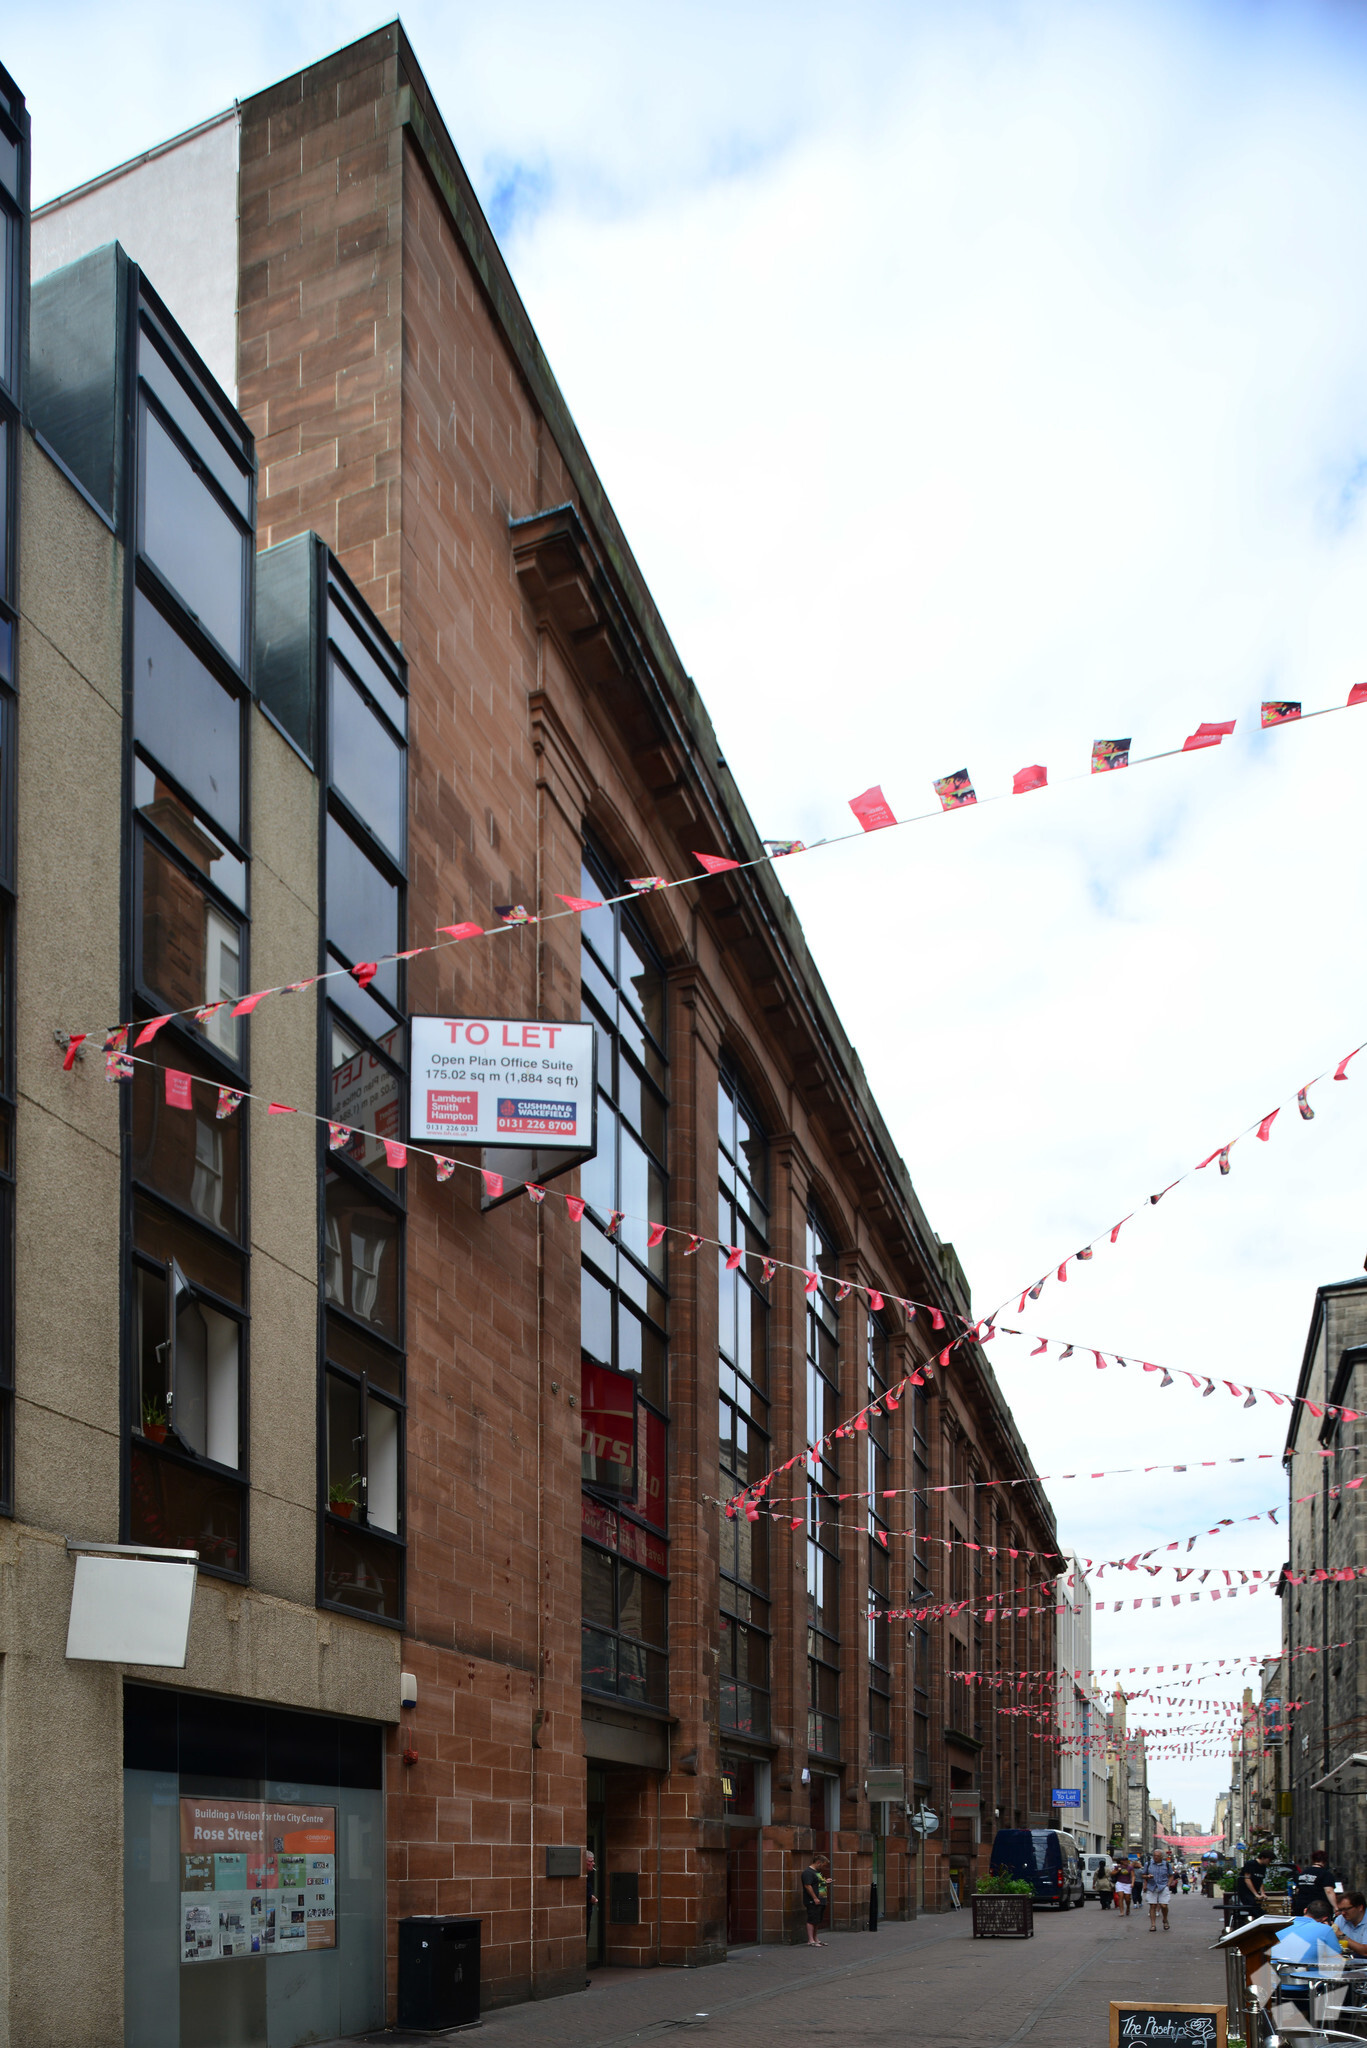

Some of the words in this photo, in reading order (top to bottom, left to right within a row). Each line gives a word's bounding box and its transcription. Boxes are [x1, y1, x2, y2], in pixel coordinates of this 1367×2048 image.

[444, 1021, 490, 1046] TO
[502, 1024, 562, 1049] LET
[431, 1054, 465, 1067] Open
[469, 1055, 497, 1067] Plan
[500, 1057, 538, 1069] Office
[542, 1059, 573, 1071] Suite
[426, 1069, 466, 1081] 175.02
[470, 1072, 485, 1083] sq
[490, 1073, 501, 1082] m
[505, 1071, 543, 1084] (1,884
[547, 1076, 562, 1087] sq
[566, 1075, 579, 1088] ft)
[432, 1093, 471, 1103] Lambert
[432, 1102, 459, 1112] Smith
[517, 1102, 565, 1112] CUSHMAN
[518, 1108, 570, 1119] WAKEFIELD
[431, 1111, 474, 1121] Hampton
[499, 1118, 523, 1128] 0131
[527, 1119, 546, 1129] 226
[548, 1121, 573, 1131] 8700
[195, 1808, 229, 1821] Building
[230, 1812, 235, 1820] a
[237, 1810, 260, 1821] Vision
[261, 1811, 272, 1821] for
[273, 1812, 286, 1822] the
[286, 1813, 301, 1825] City
[301, 1814, 324, 1823] Centre
[193, 1826, 225, 1840] Rose
[227, 1827, 264, 1841] Street
[1121, 2015, 1142, 2040] The
[1144, 2016, 1187, 2044] Rosehip
